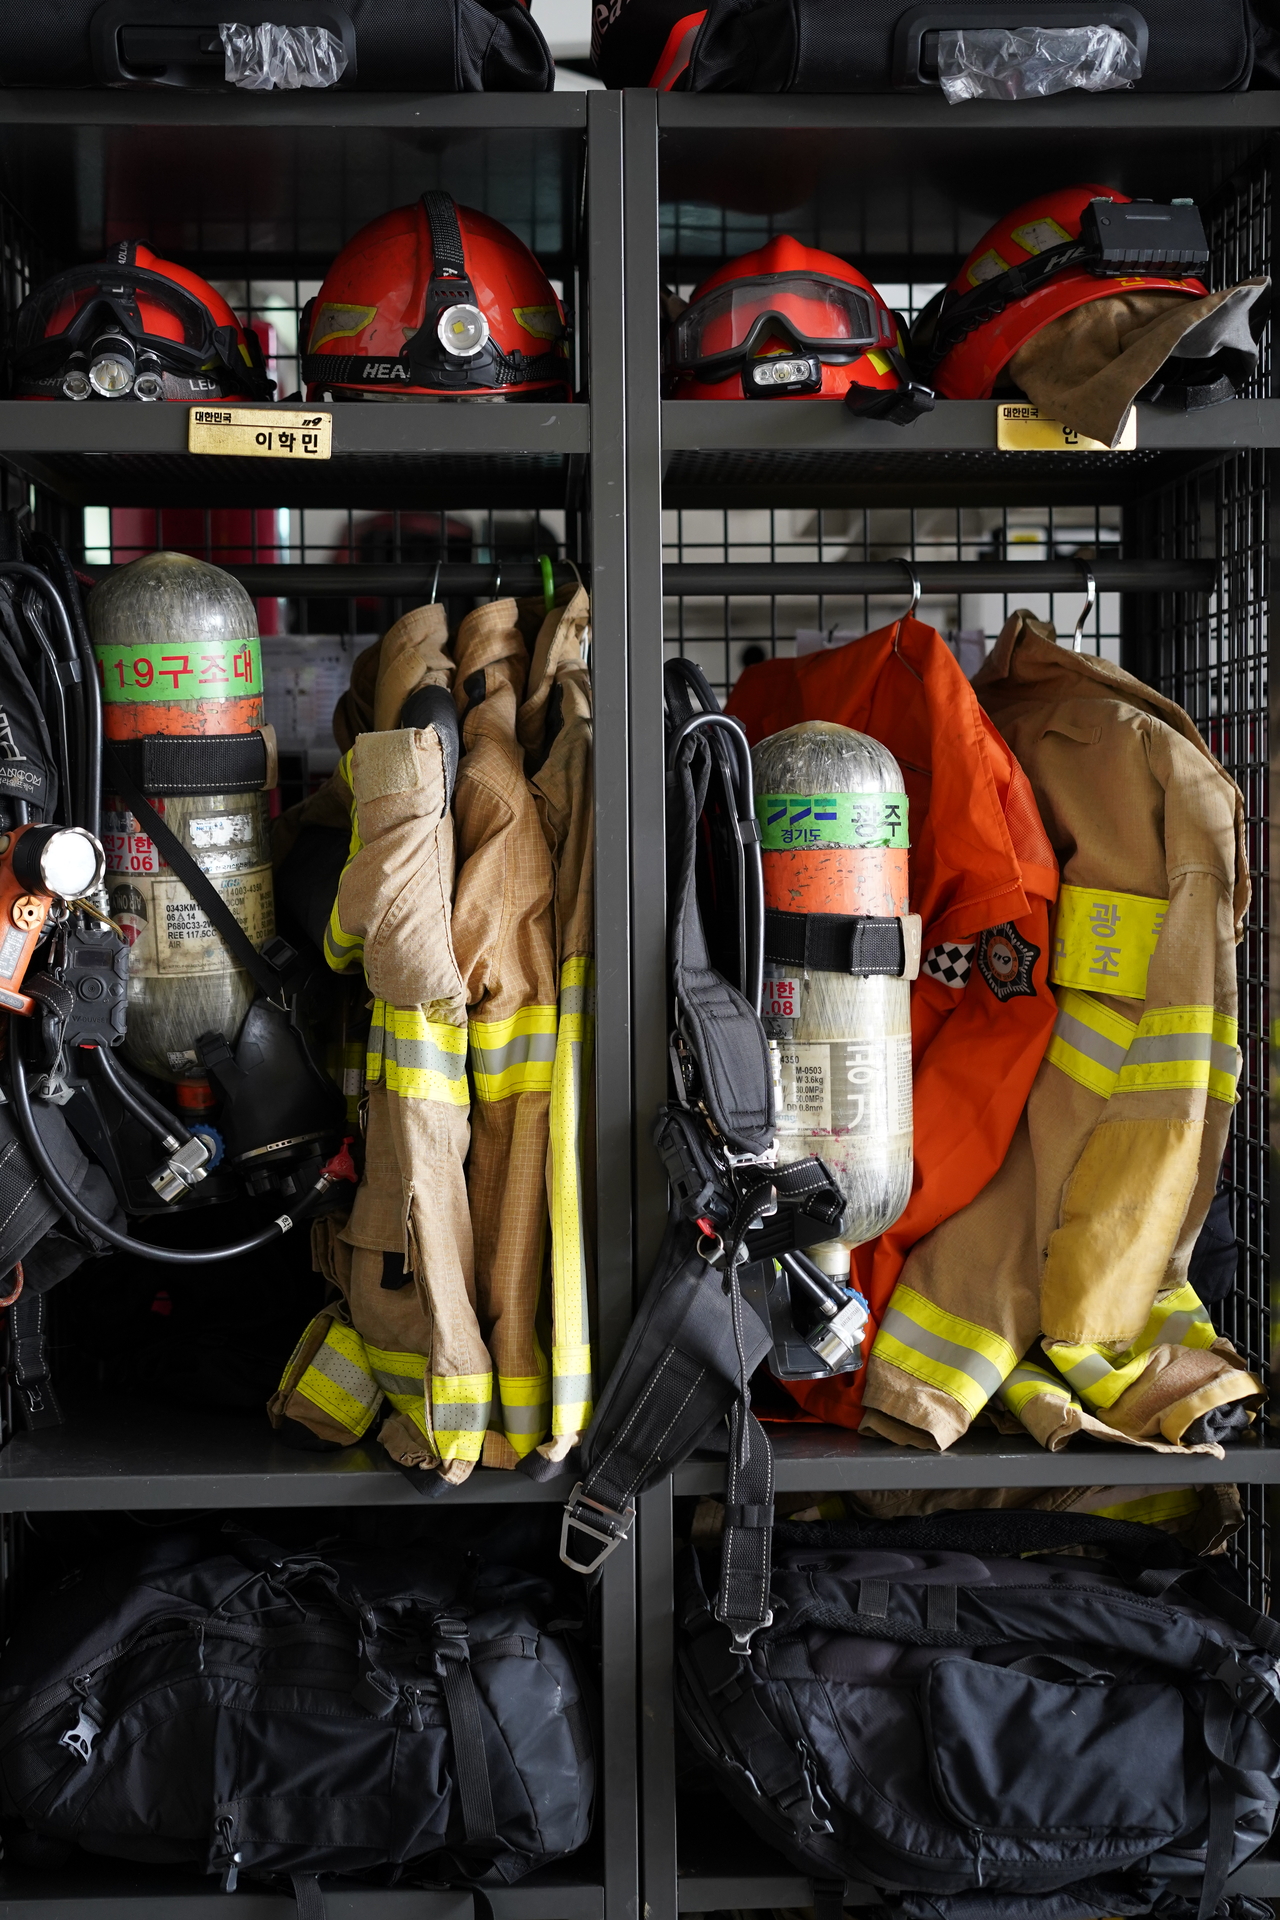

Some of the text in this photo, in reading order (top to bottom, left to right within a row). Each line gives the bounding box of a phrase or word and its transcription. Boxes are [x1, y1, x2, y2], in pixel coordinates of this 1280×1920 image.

[362, 363, 411, 378] HEA
[189, 379, 217, 391] LED
[195, 411, 232, 424] 대한민국
[1003, 407, 1039, 419] 대한민국
[255, 431, 319, 454] 이학민
[97, 649, 253, 690] 119구조대
[780, 829, 822, 844] 경기도
[166, 904, 204, 913] 0343KM1
[187, 912, 196, 921] 14
[168, 929, 217, 939] REE 117.5CC
[168, 940, 182, 949] AIR
[761, 1000, 794, 1016] .08
[780, 1055, 800, 1064] 4350
[796, 1066, 823, 1075] M-0503
[796, 1076, 824, 1086] W 3.6kg
